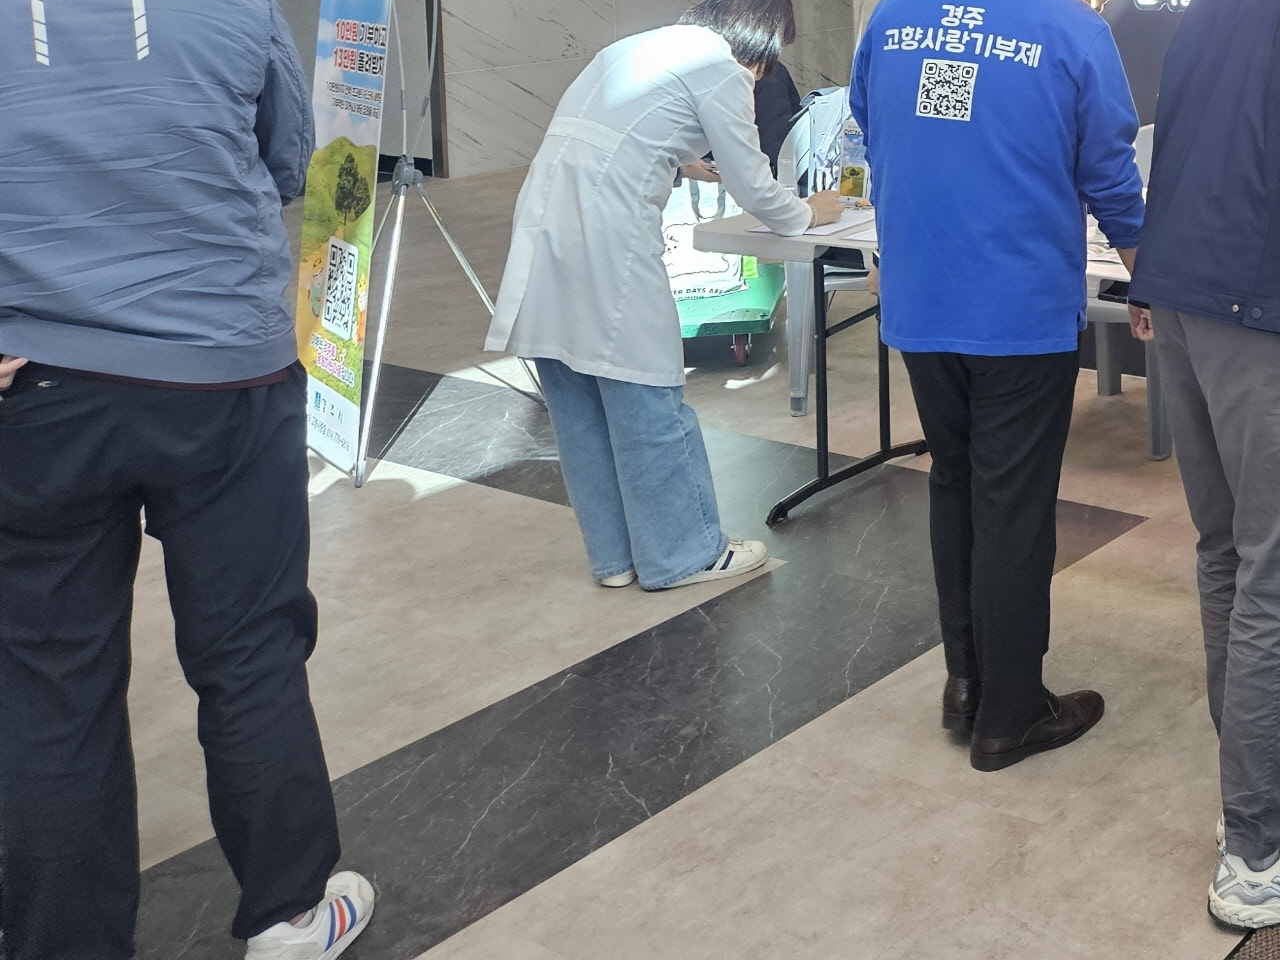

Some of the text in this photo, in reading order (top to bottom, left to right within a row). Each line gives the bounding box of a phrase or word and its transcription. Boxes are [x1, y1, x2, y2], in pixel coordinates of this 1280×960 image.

[940, 4, 986, 29] 경주
[335, 20, 358, 43] 10만원
[883, 25, 1043, 68] 고향사랑기부제
[333, 48, 357, 71] 13만원
